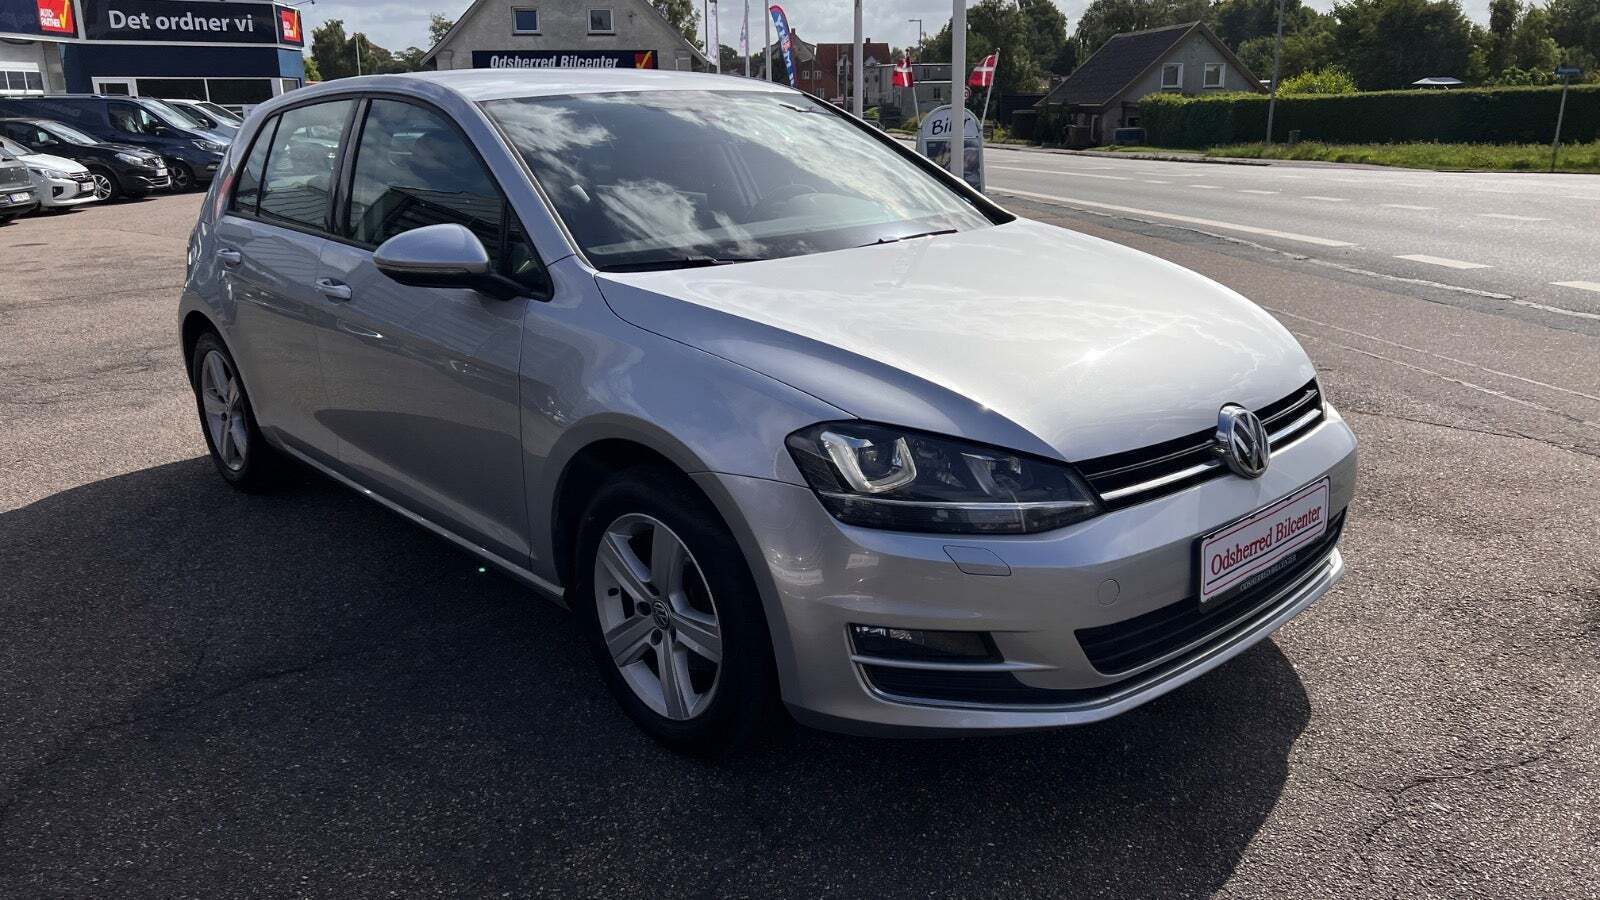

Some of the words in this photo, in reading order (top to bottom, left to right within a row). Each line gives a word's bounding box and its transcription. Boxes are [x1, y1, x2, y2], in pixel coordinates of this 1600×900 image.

[108, 10, 150, 30] Det
[155, 12, 230, 31] ordner
[234, 14, 254, 32] vi
[490, 55, 556, 69] Odsherred
[560, 55, 618, 69] Bilcenter
[1211, 527, 1272, 575] Odsherred
[1275, 506, 1322, 544] Bilcenter
